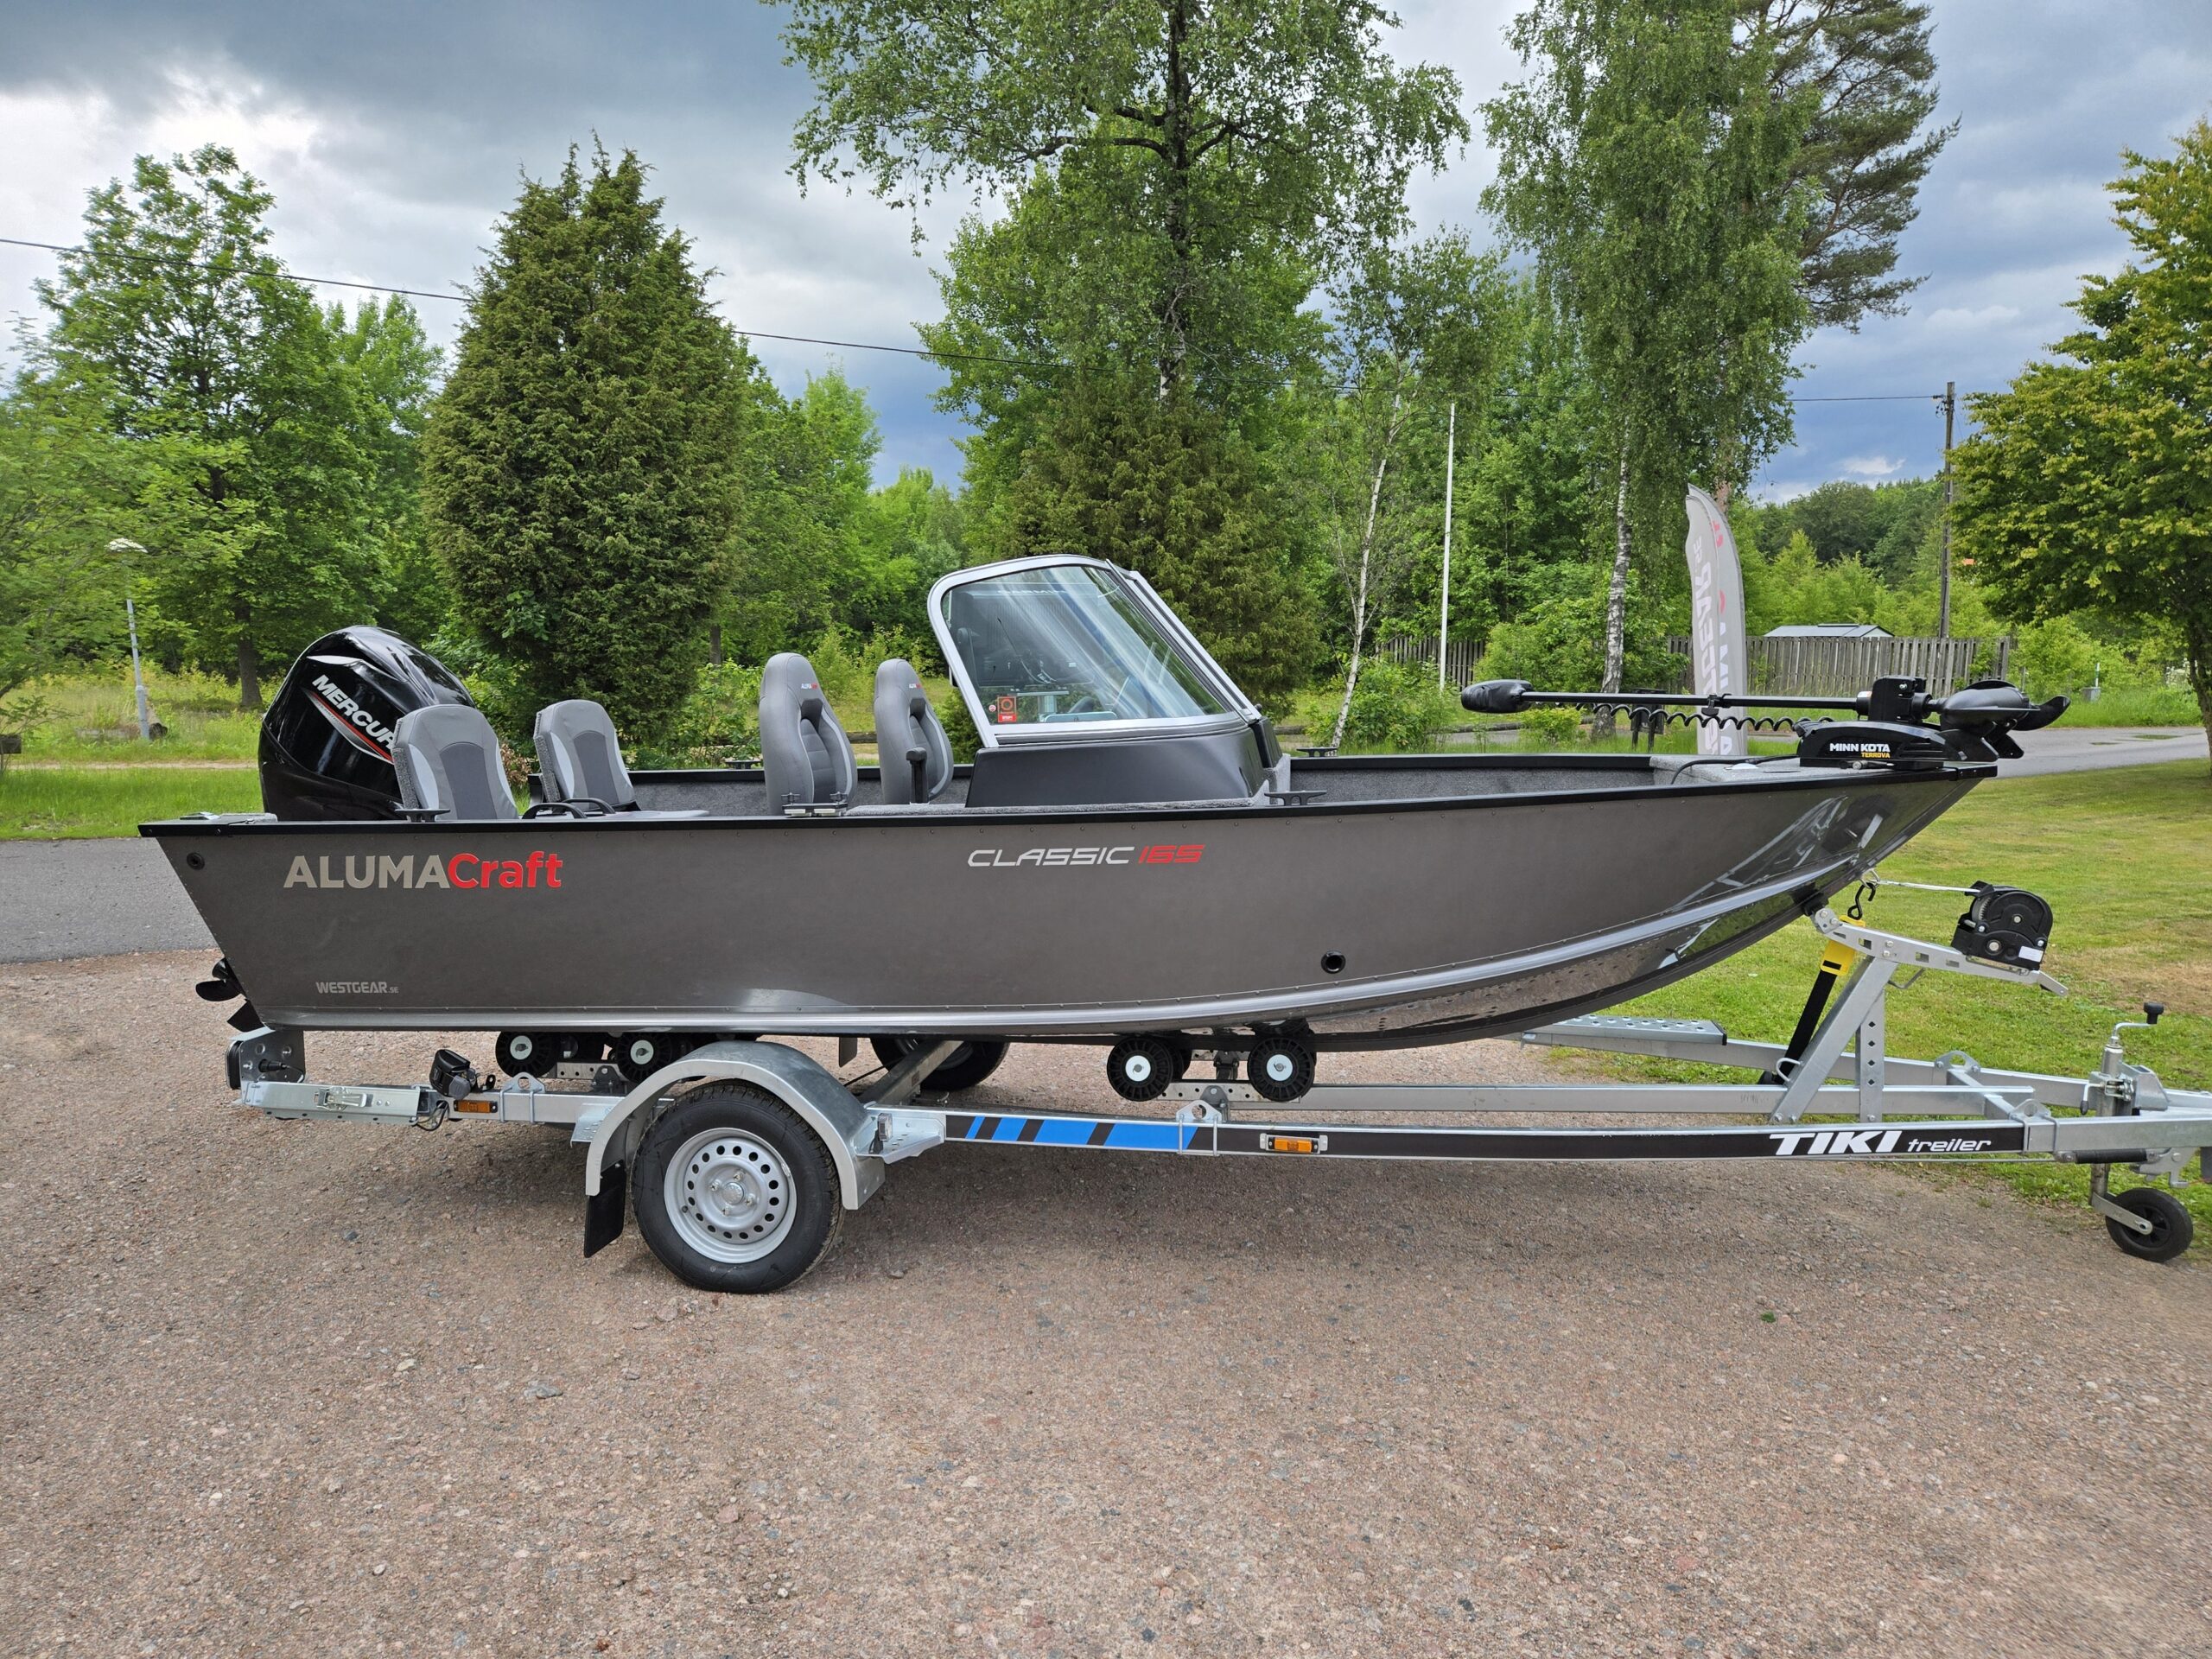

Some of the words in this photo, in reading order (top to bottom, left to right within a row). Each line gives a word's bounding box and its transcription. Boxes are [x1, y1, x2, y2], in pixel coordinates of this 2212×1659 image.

[312, 674, 395, 751] MERCUR
[1829, 743, 1859, 752] MINN
[1860, 743, 1891, 753] KOTA
[967, 847, 1135, 867] CLASSIC
[1137, 844, 1206, 864] 165
[283, 850, 563, 889] ALUMACraft
[1770, 1130, 1902, 1156] TIKI
[1908, 1138, 1991, 1153] treiler
